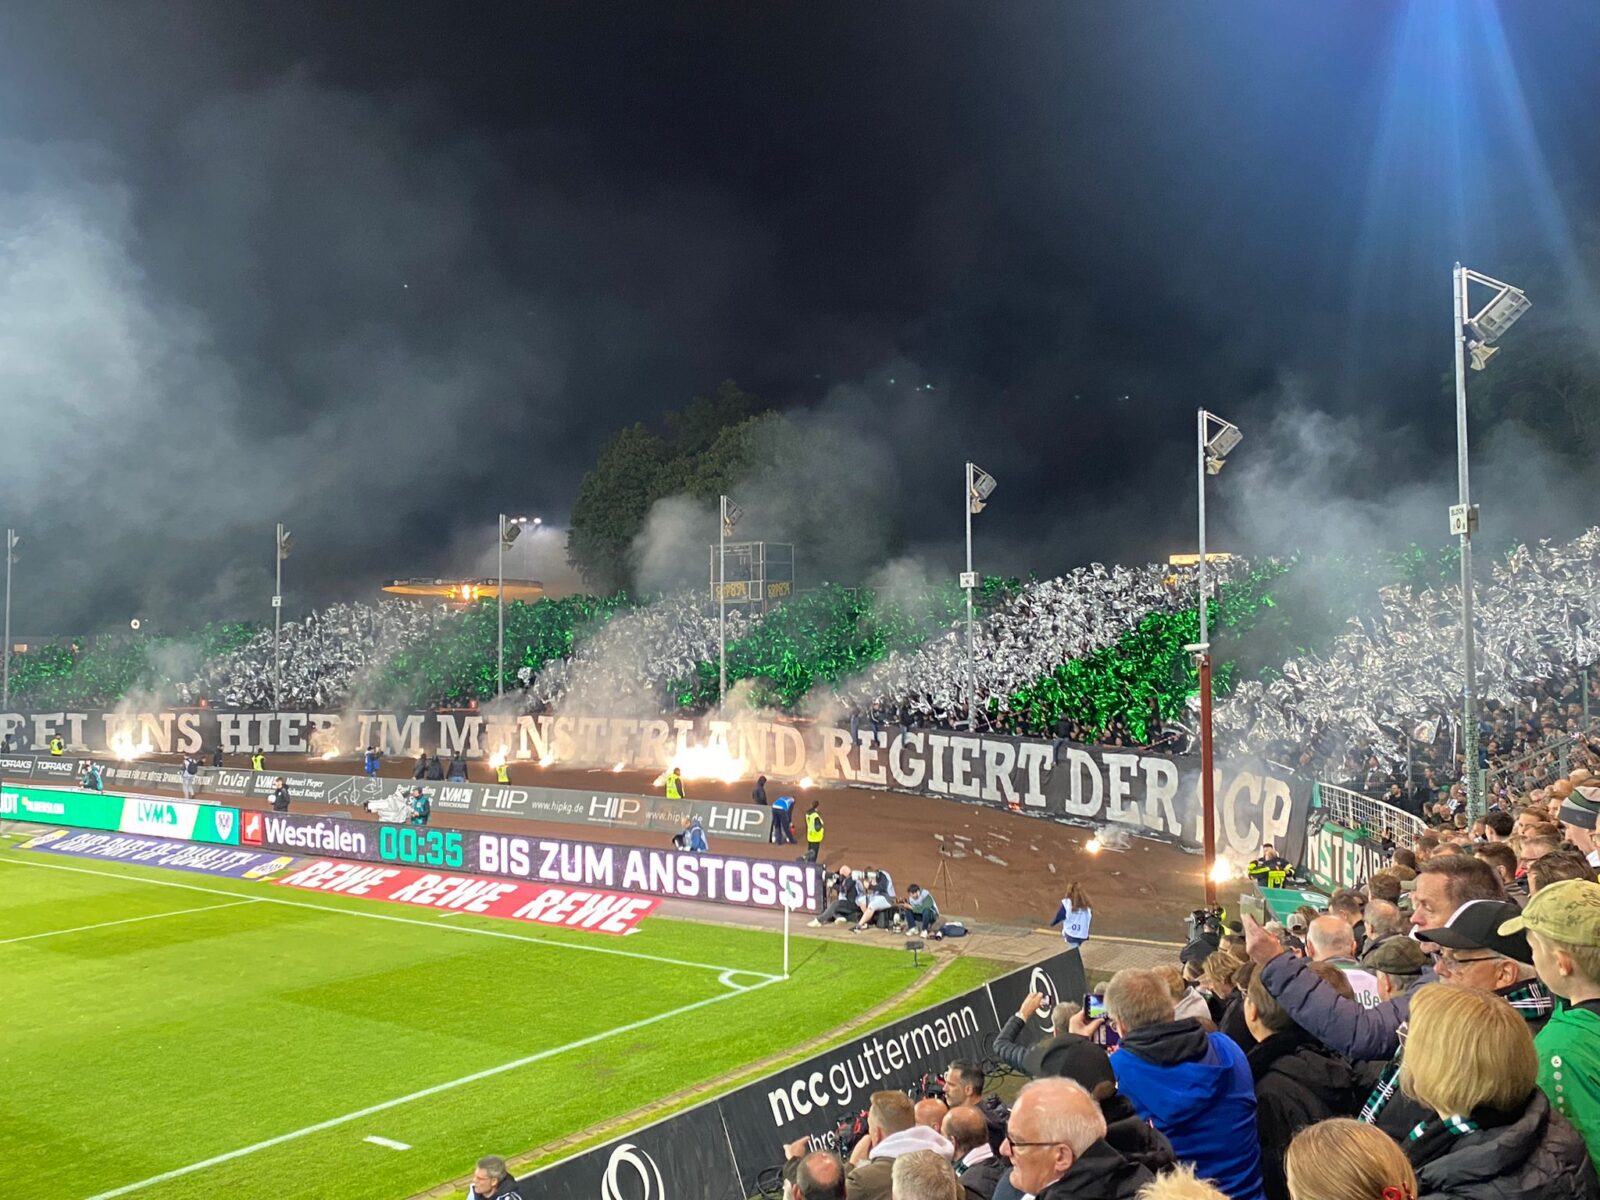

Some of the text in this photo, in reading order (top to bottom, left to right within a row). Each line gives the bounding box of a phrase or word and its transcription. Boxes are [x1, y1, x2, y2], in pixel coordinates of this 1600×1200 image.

[353, 714, 426, 756] IM
[819, 727, 1054, 808] REGIERT
[1065, 747, 1182, 837] DER
[440, 786, 463, 802] LVM
[481, 788, 529, 810] HIP
[531, 801, 584, 815] www.hipkg.de
[588, 796, 641, 819] HIP
[137, 801, 164, 825] LVM
[708, 806, 764, 831] HIP
[264, 816, 367, 854] Westfalen
[379, 826, 464, 868] 00:35
[479, 835, 817, 912] BIS ZUM ANSTOSS!
[279, 861, 652, 933] REWE REWE REWE
[767, 1004, 980, 1127] ncc guttermann
